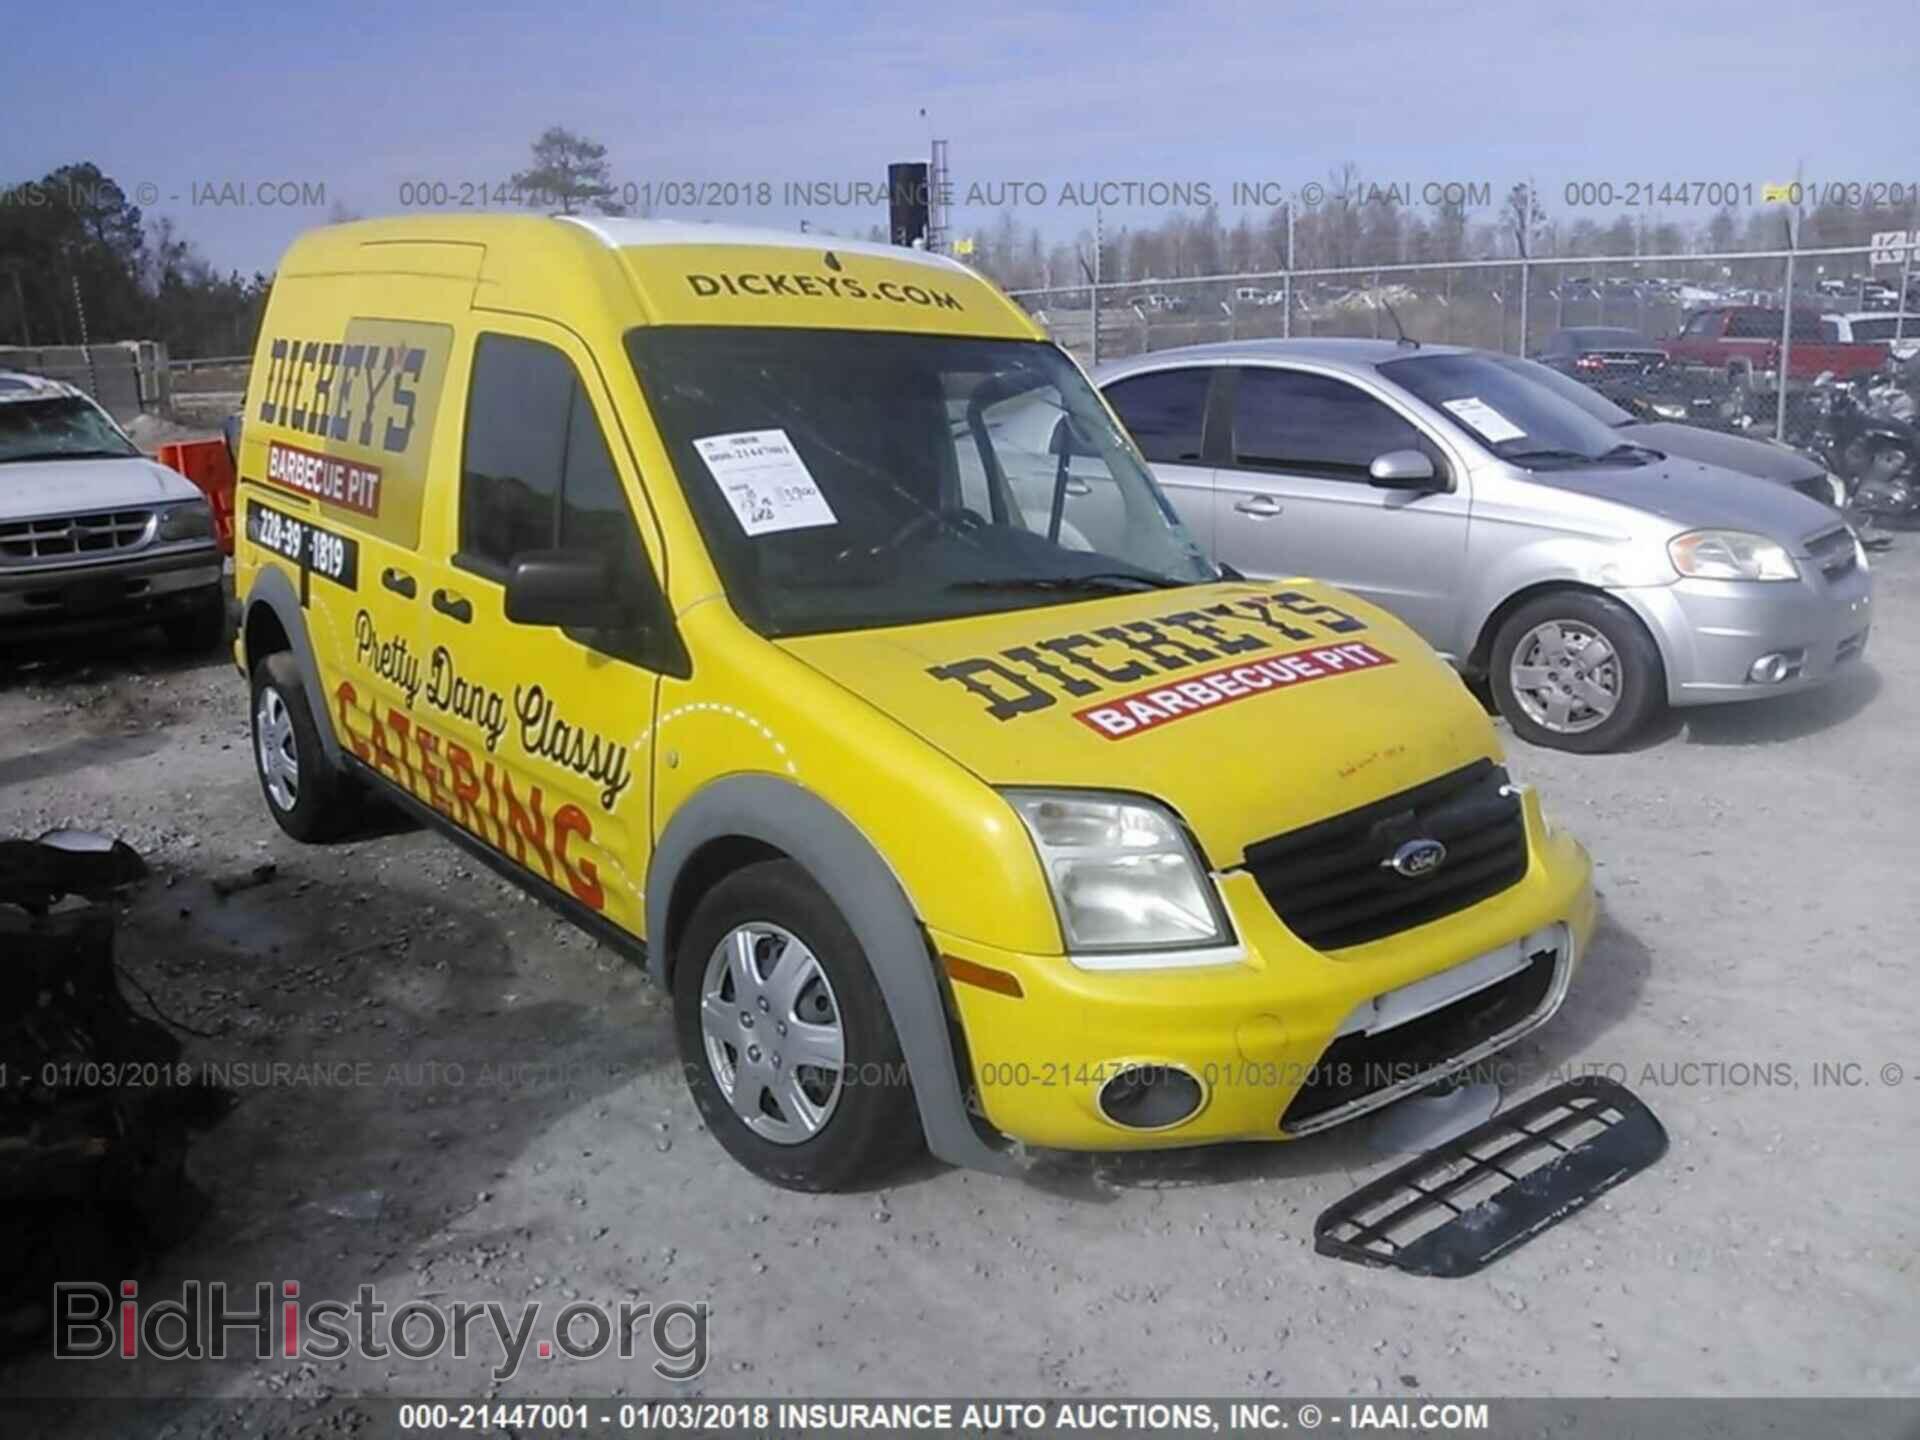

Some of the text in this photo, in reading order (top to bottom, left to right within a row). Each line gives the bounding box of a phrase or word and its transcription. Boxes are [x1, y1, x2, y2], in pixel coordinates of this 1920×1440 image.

[687, 274, 964, 311] DICKEYS.COM
[269, 446, 379, 509] BARBECUE PIT
[355, 608, 631, 811] Pretty Dang Classy
[1087, 644, 1381, 735] BARBECUE PIT
[336, 681, 605, 911] CATERING
